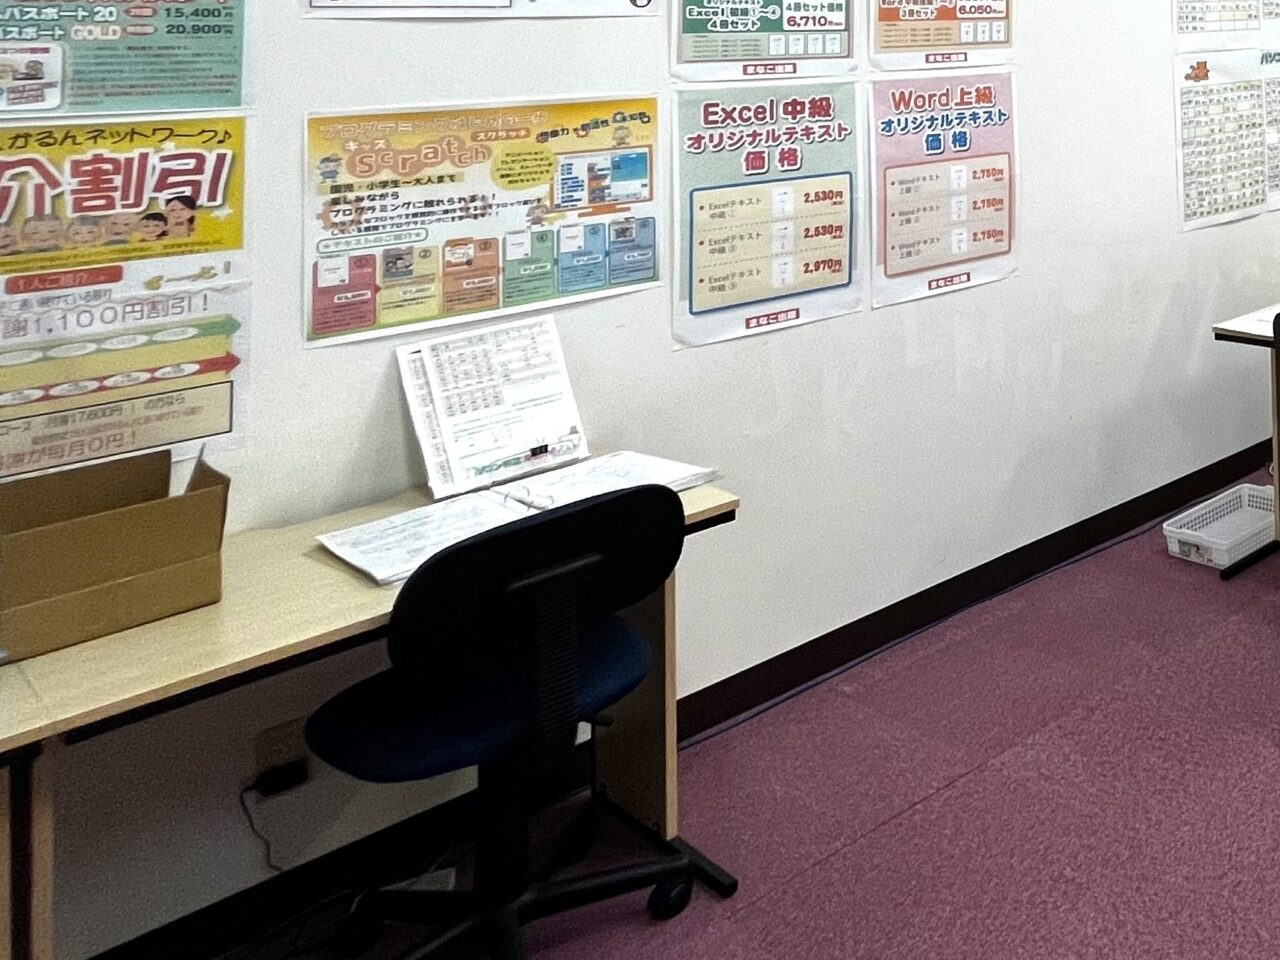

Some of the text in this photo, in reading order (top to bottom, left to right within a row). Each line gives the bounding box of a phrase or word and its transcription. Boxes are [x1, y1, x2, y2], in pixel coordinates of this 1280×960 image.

[93, 6, 118, 22] 20
[164, 7, 222, 19] 15,400
[687, 7, 726, 18] Excel
[69, 24, 122, 41] GOLD
[165, 24, 223, 35] 20,900
[890, 85, 994, 112] Word 上級
[702, 96, 833, 126] Excel 中級
[880, 108, 1008, 134] オリジナルテキスト
[686, 121, 851, 152] オリジナルテキスト
[344, 139, 388, 151] キッズ
[803, 189, 844, 204] 2,530円
[803, 224, 844, 240] 2,530円
